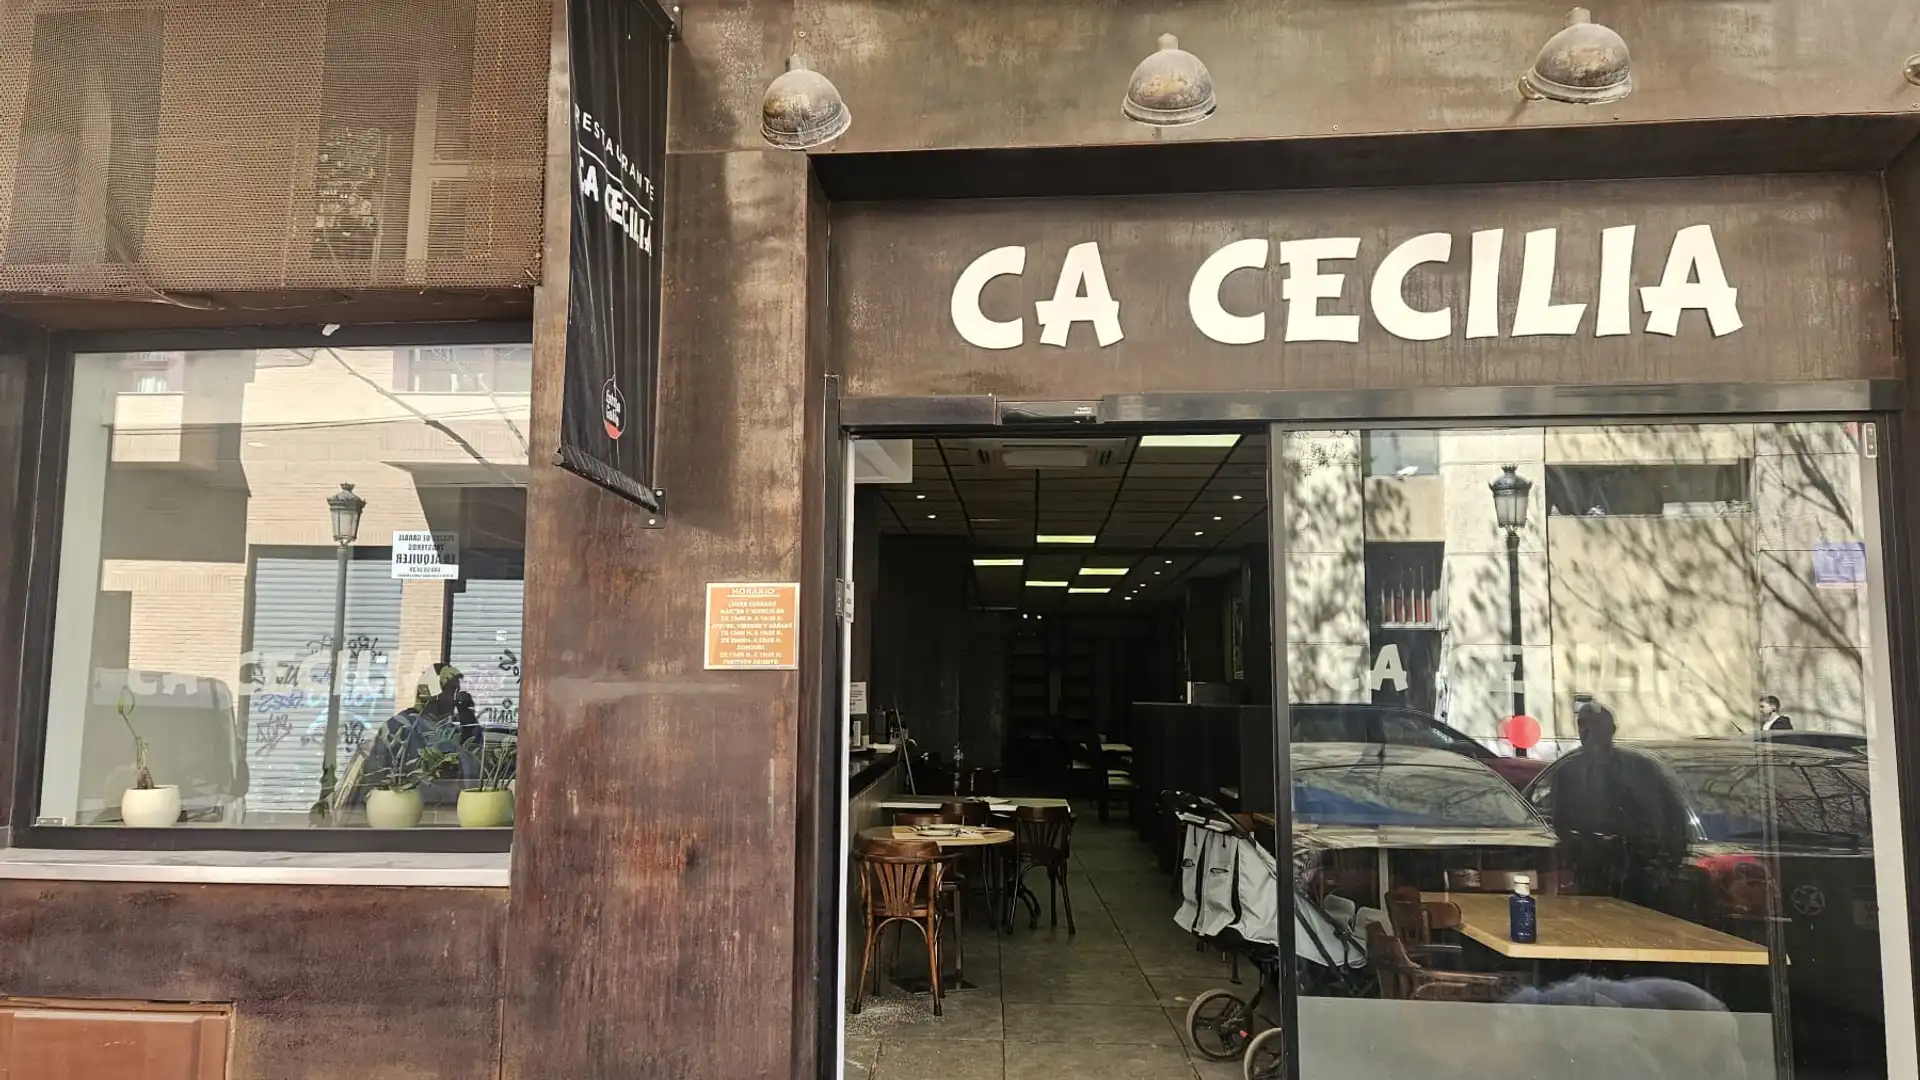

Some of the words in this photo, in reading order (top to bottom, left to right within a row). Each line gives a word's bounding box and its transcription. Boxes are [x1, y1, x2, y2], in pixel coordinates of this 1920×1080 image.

[574, 102, 654, 202] RESTAURANTE
[604, 183, 652, 257] CECILIA
[951, 241, 1124, 349] CA
[1189, 224, 1743, 343] CECILIA
[1324, 643, 1408, 692] CA
